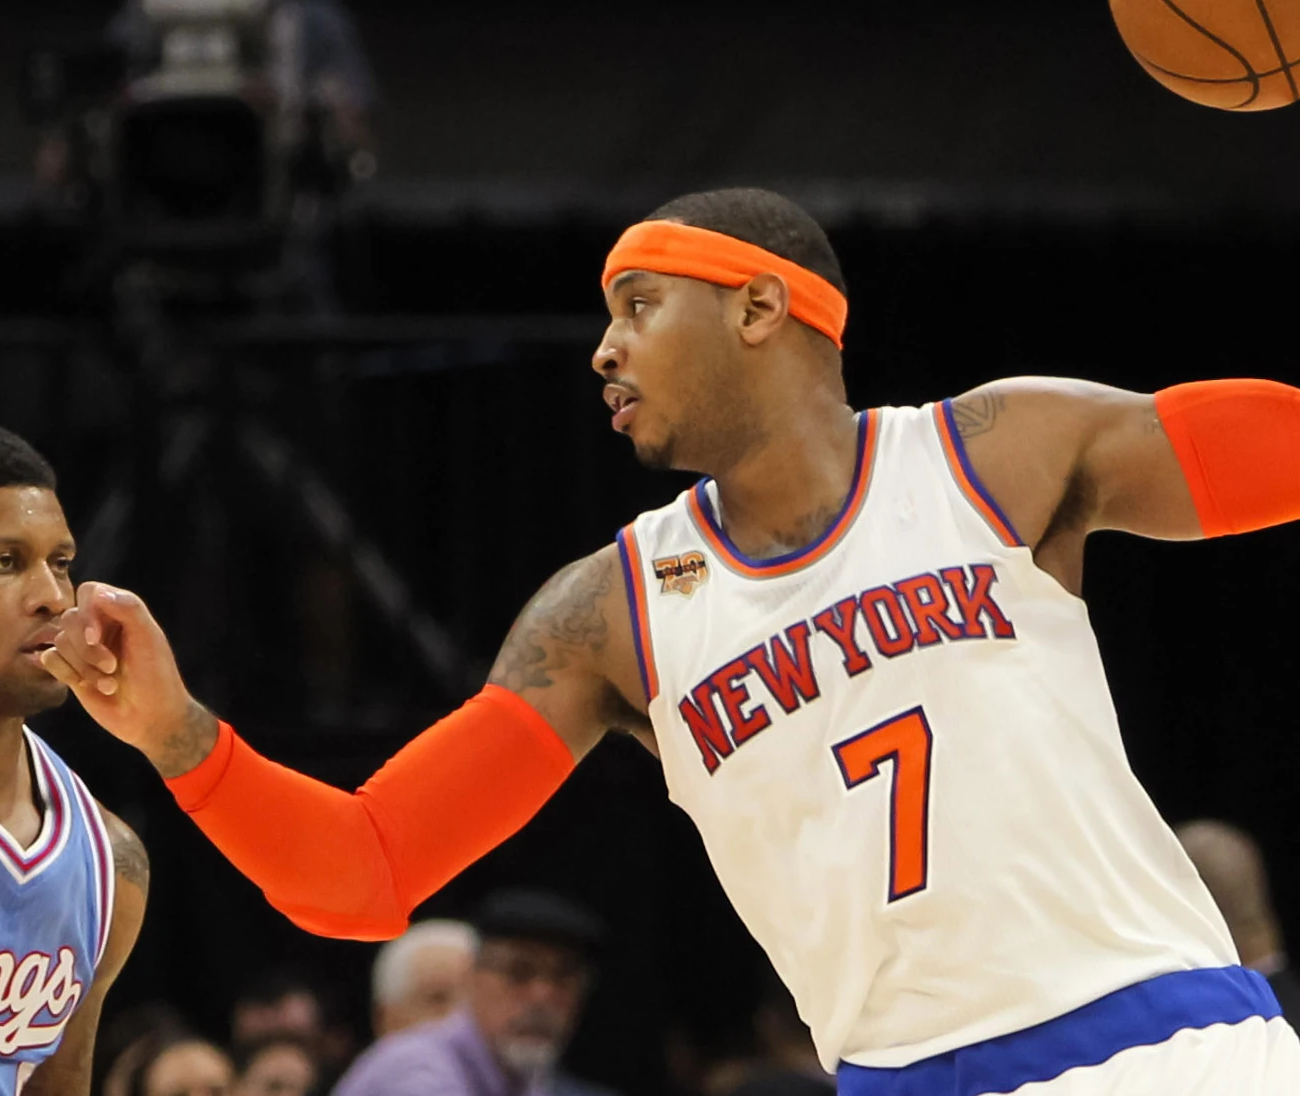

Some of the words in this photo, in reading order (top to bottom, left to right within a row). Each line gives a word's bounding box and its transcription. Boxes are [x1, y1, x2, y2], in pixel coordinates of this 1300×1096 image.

[677, 619, 821, 777] NEW
[812, 563, 1017, 678] YORK
[831, 704, 934, 904] 7
